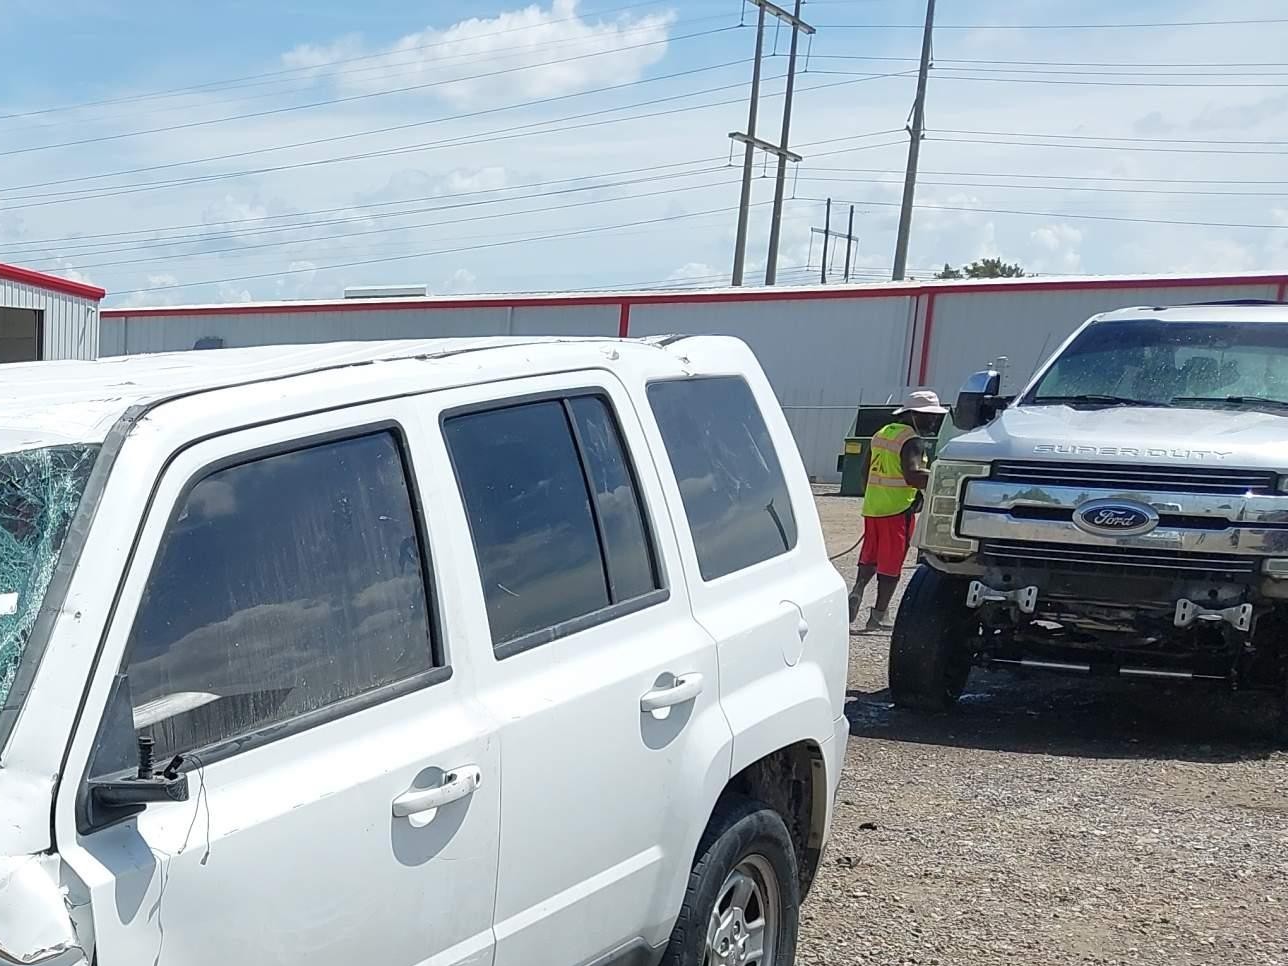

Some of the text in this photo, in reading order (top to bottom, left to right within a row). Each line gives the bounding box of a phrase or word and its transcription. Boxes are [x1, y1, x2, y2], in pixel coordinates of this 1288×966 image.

[1032, 444, 1233, 460] SUPER DUTY
[1094, 509, 1136, 526] Ford
